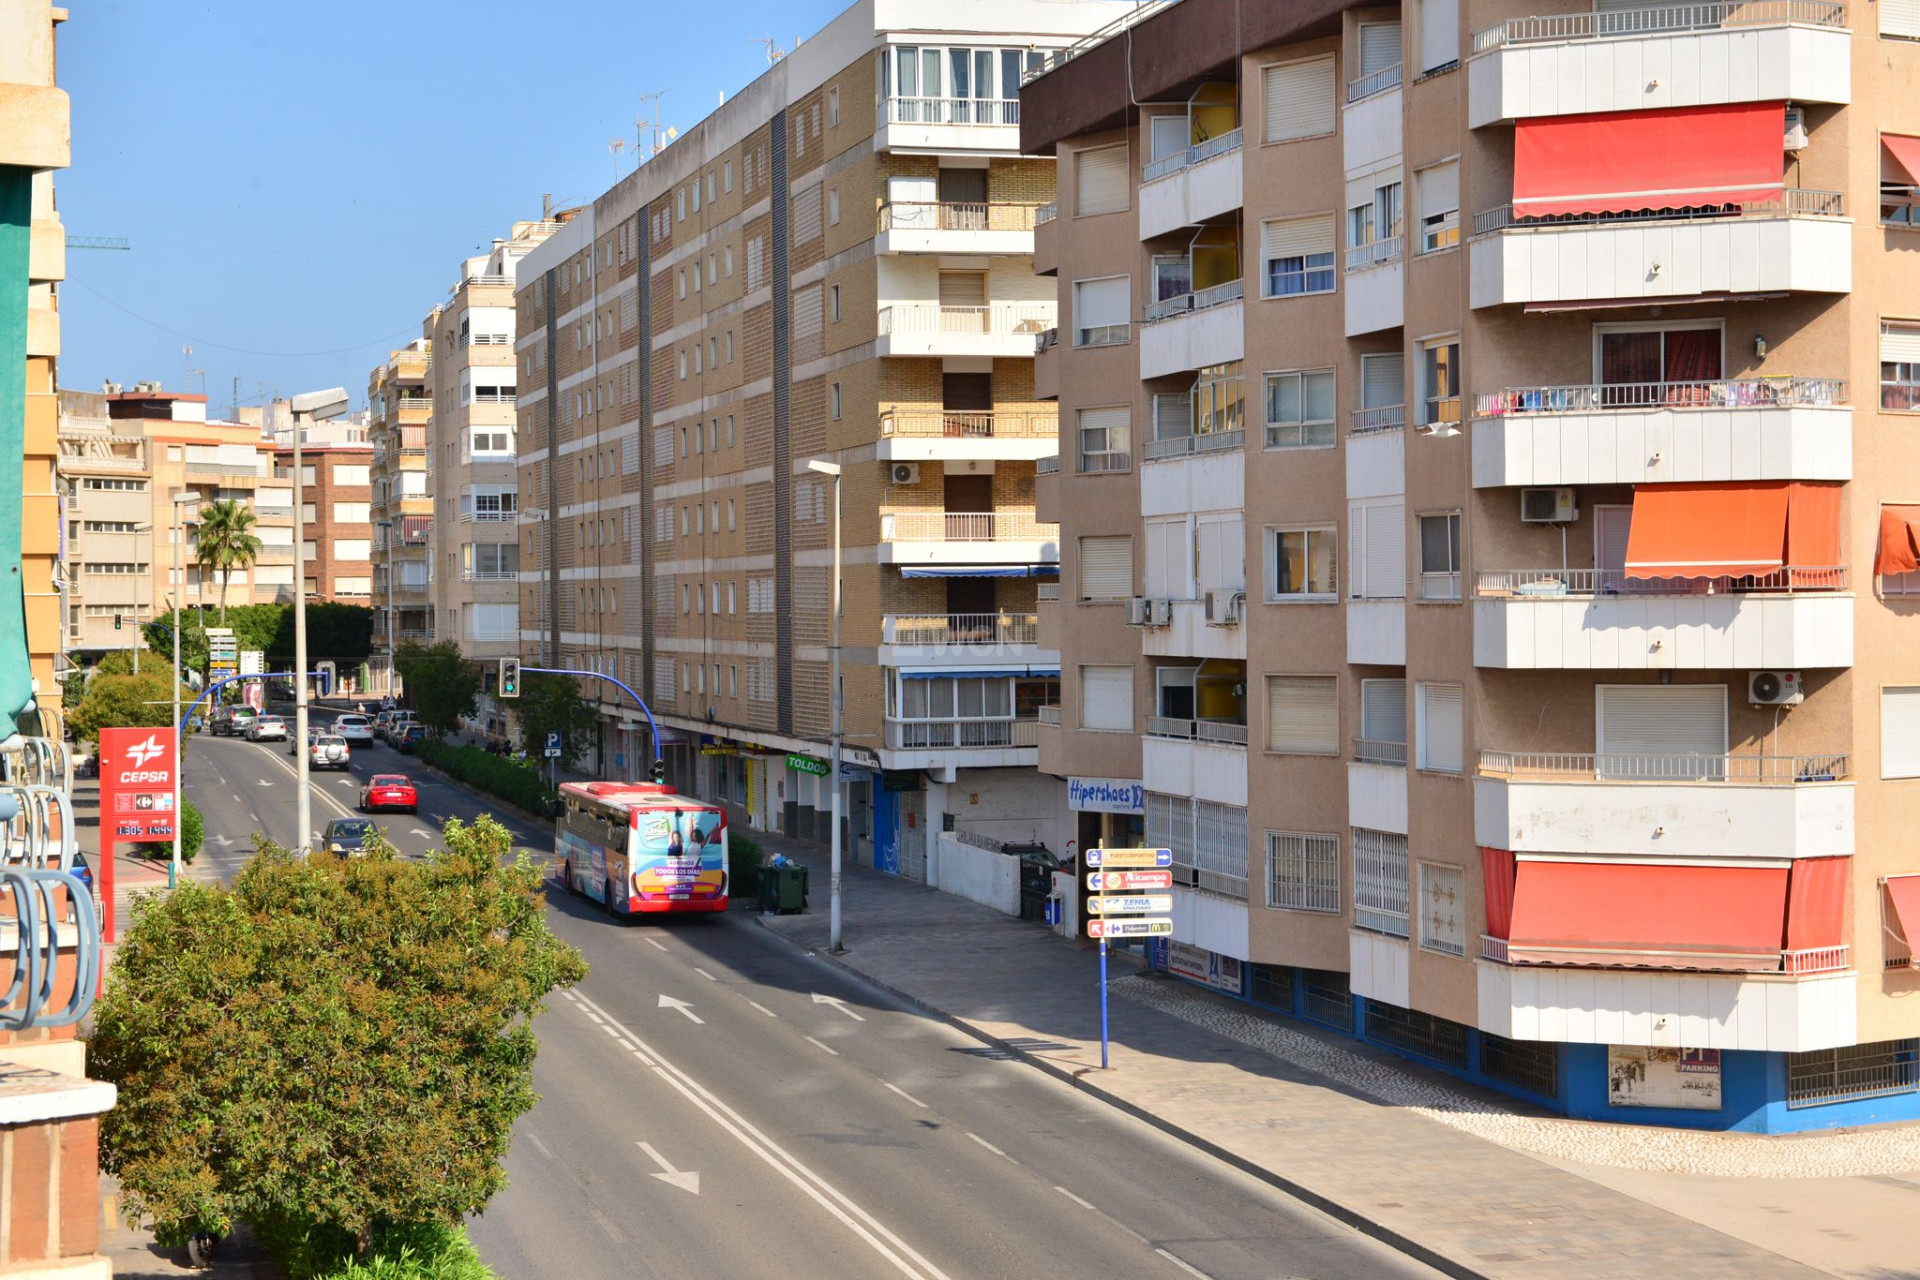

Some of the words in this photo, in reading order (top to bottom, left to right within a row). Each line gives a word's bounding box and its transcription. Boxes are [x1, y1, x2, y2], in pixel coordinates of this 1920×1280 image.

[547, 732, 558, 747] P
[788, 757, 827, 774] TOLDOS
[120, 771, 168, 783] CEPSA
[1070, 779, 1131, 809] Hipershoes
[119, 826, 143, 836] 1.305
[149, 825, 173, 835] 1.444
[1124, 898, 1151, 906] ZENIA
[1681, 1064, 1719, 1073] PARKING
